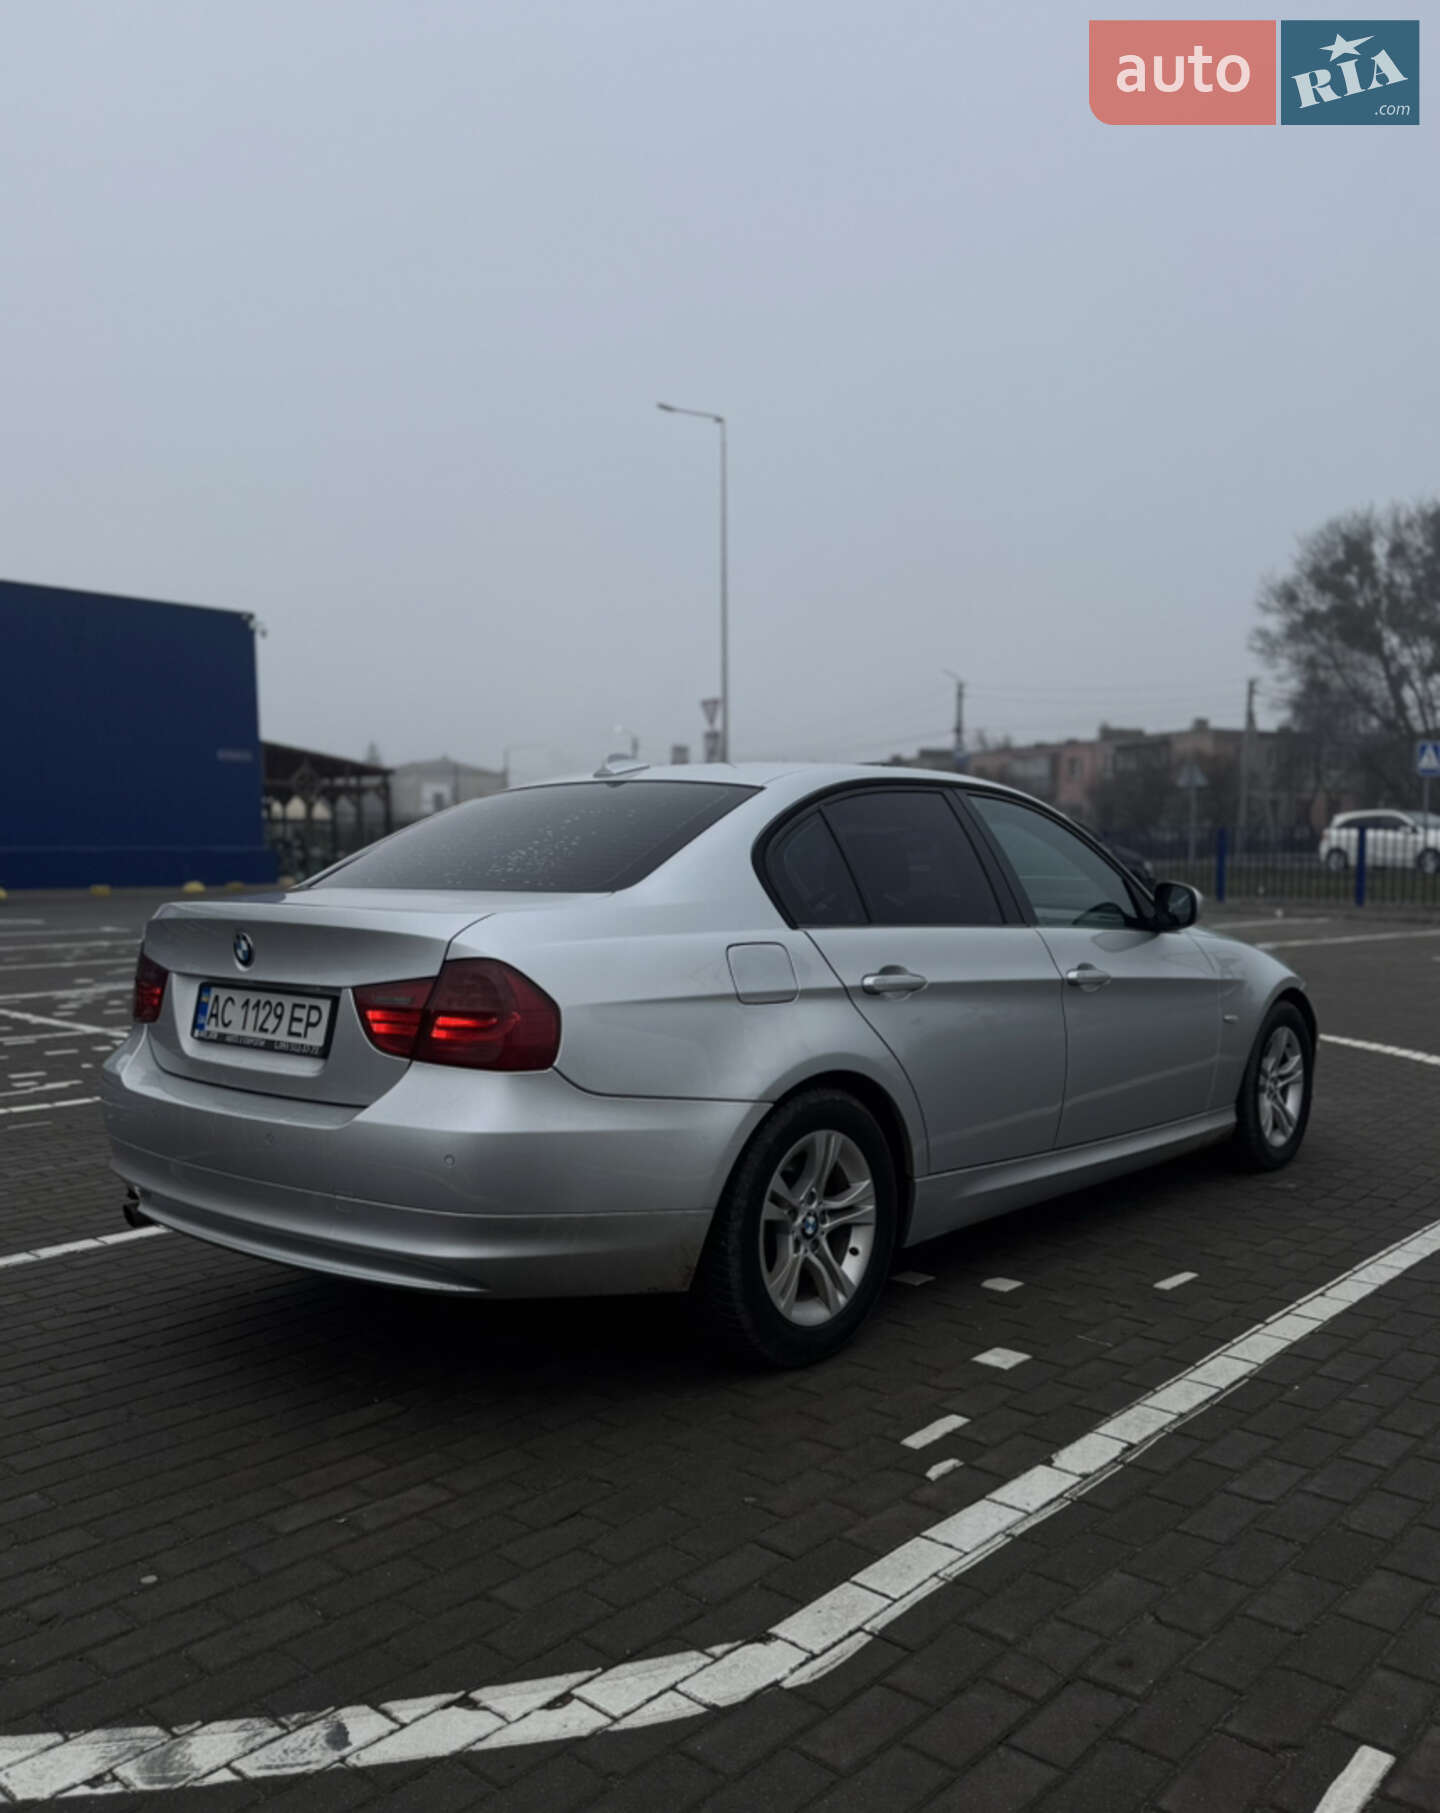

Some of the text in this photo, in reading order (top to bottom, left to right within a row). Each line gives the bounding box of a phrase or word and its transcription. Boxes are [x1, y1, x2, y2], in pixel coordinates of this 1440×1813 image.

[207, 994, 323, 1039] AC 1129 EP
